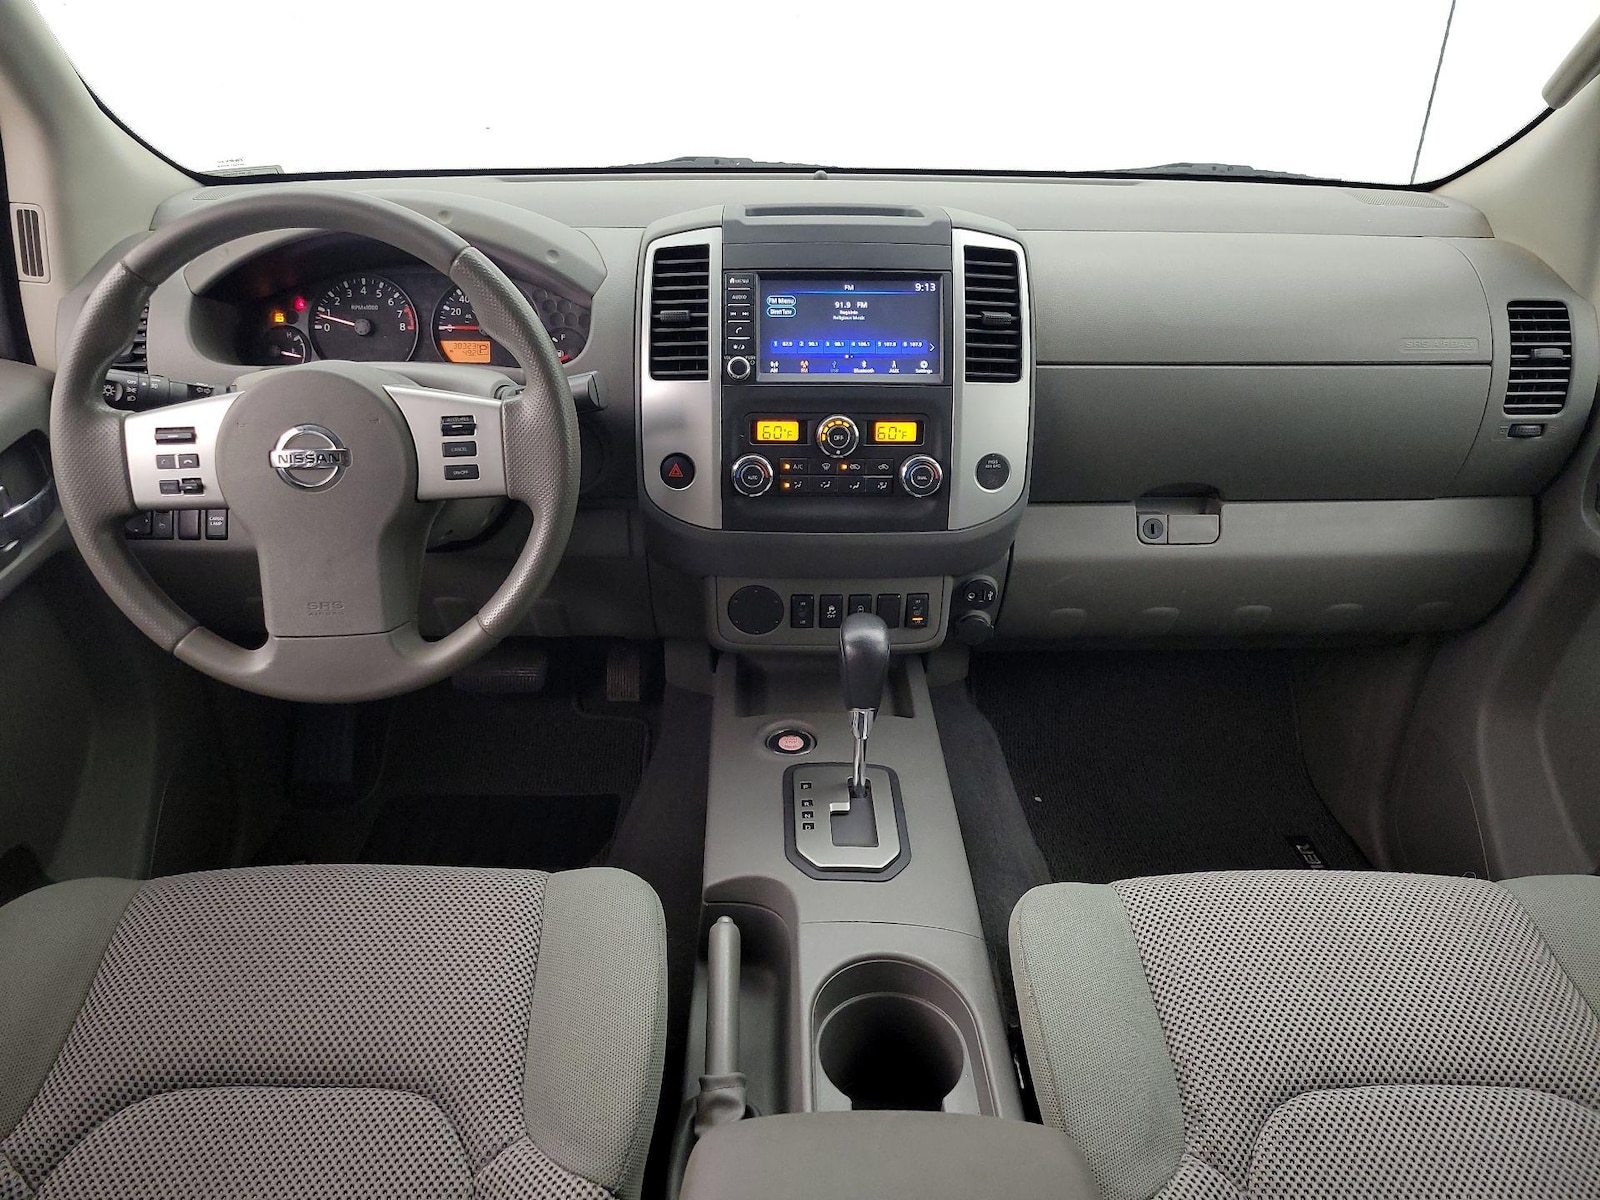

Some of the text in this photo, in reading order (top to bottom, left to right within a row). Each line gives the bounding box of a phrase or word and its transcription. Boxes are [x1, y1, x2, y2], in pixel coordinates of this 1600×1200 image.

[360, 286, 366, 294] 4
[915, 282, 936, 292] 9:13
[346, 289, 352, 298] 3
[376, 290, 382, 298] 5
[334, 297, 340, 305] 2
[388, 298, 394, 306] 6
[397, 310, 402, 318] 7
[324, 324, 330, 332] 0
[400, 323, 406, 331] 8
[480, 344, 487, 354] P
[278, 454, 340, 464] NISSAN
